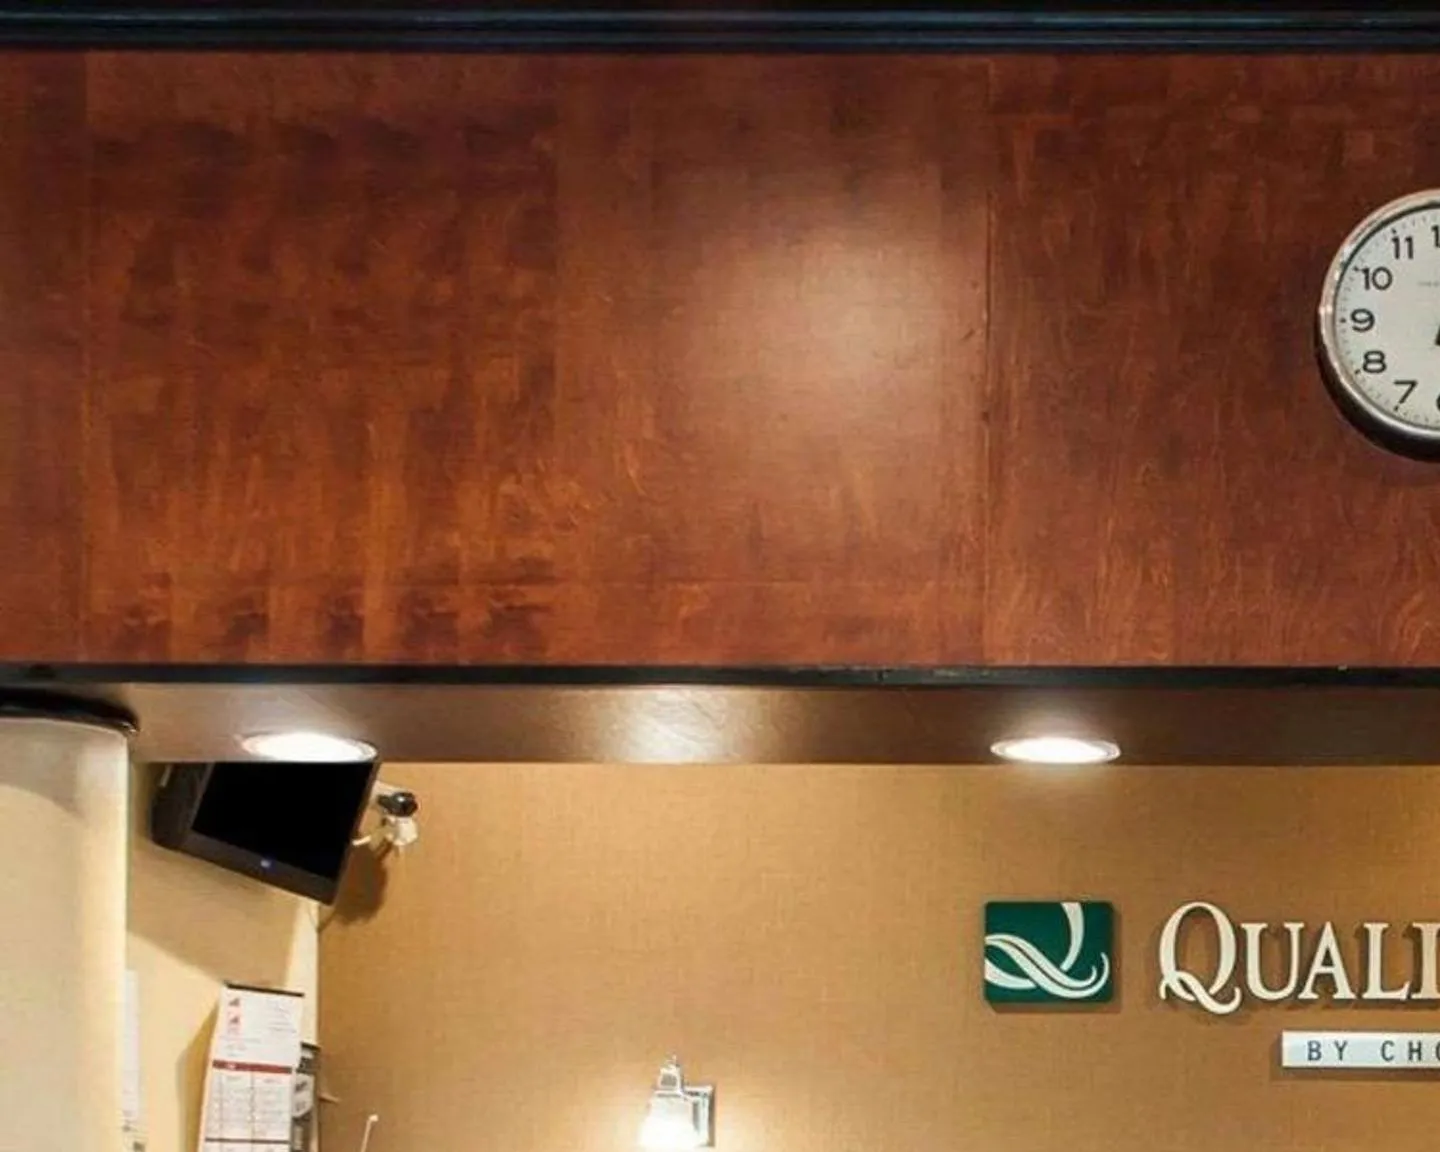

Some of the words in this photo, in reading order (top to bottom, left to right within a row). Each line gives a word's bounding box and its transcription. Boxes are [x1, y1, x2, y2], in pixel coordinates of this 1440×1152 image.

[1392, 236, 1413, 259] 11
[1362, 267, 1393, 290] 10
[1351, 309, 1375, 331] 9
[1363, 351, 1387, 373] 8
[1394, 380, 1417, 404] 7
[1307, 1040, 1348, 1061] BY
